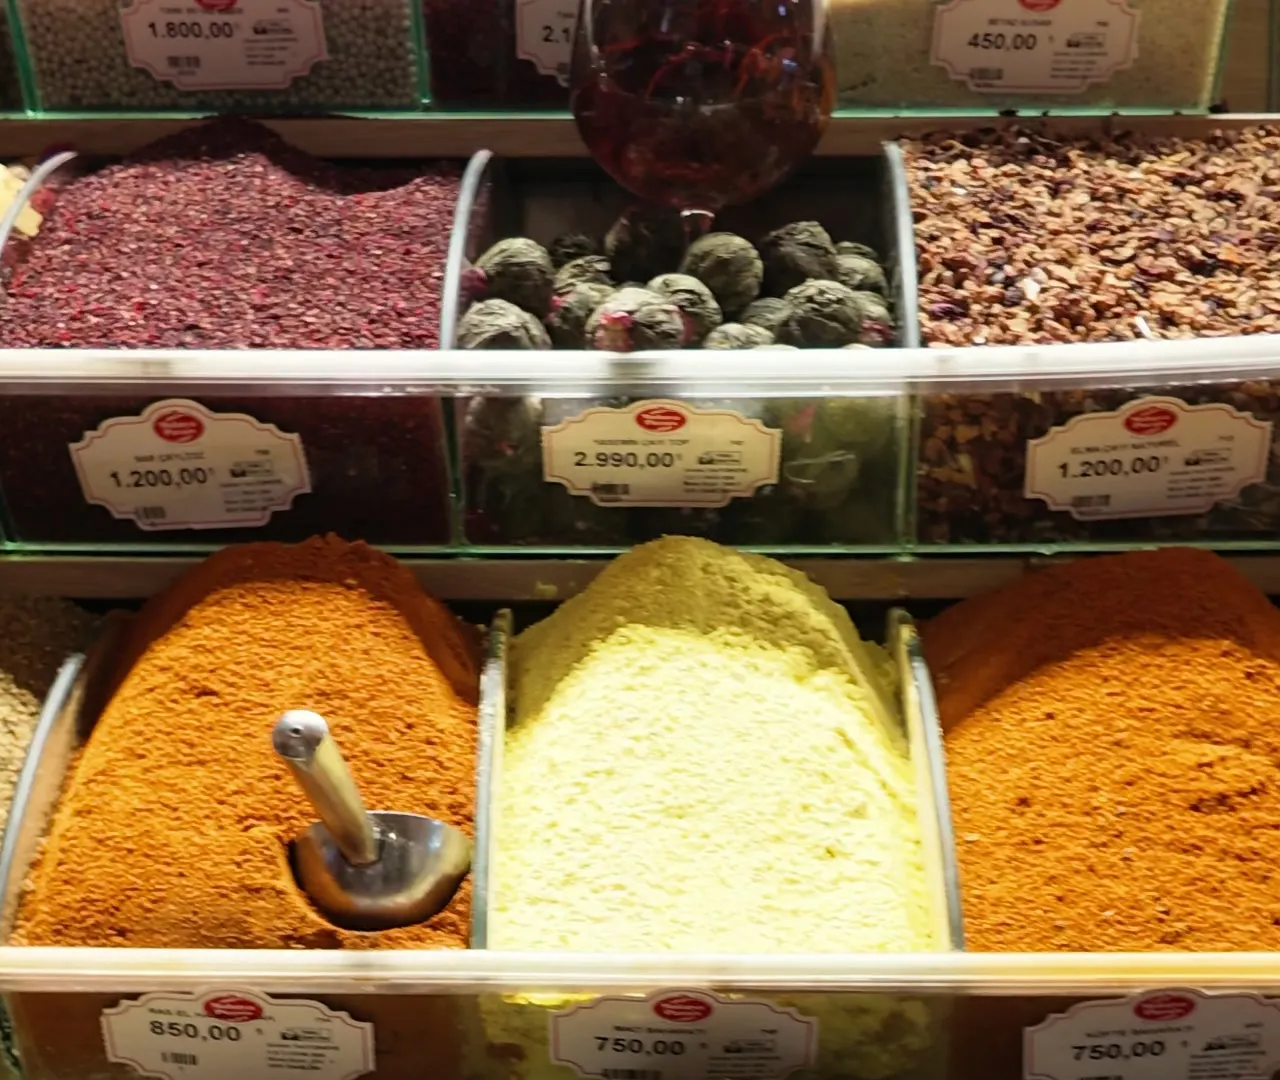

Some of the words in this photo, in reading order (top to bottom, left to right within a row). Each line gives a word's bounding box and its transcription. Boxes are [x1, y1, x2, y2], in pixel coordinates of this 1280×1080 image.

[148, 22, 234, 40] 1.800,00
[967, 33, 1037, 51] 450,00
[574, 452, 674, 469] 2.990,00
[1057, 455, 1161, 478] 1.200,00
[110, 467, 208, 488] 1.200,00
[149, 1020, 241, 1042] 850,00
[593, 1036, 685, 1056] 750,00
[1071, 1040, 1166, 1061] 750,00
